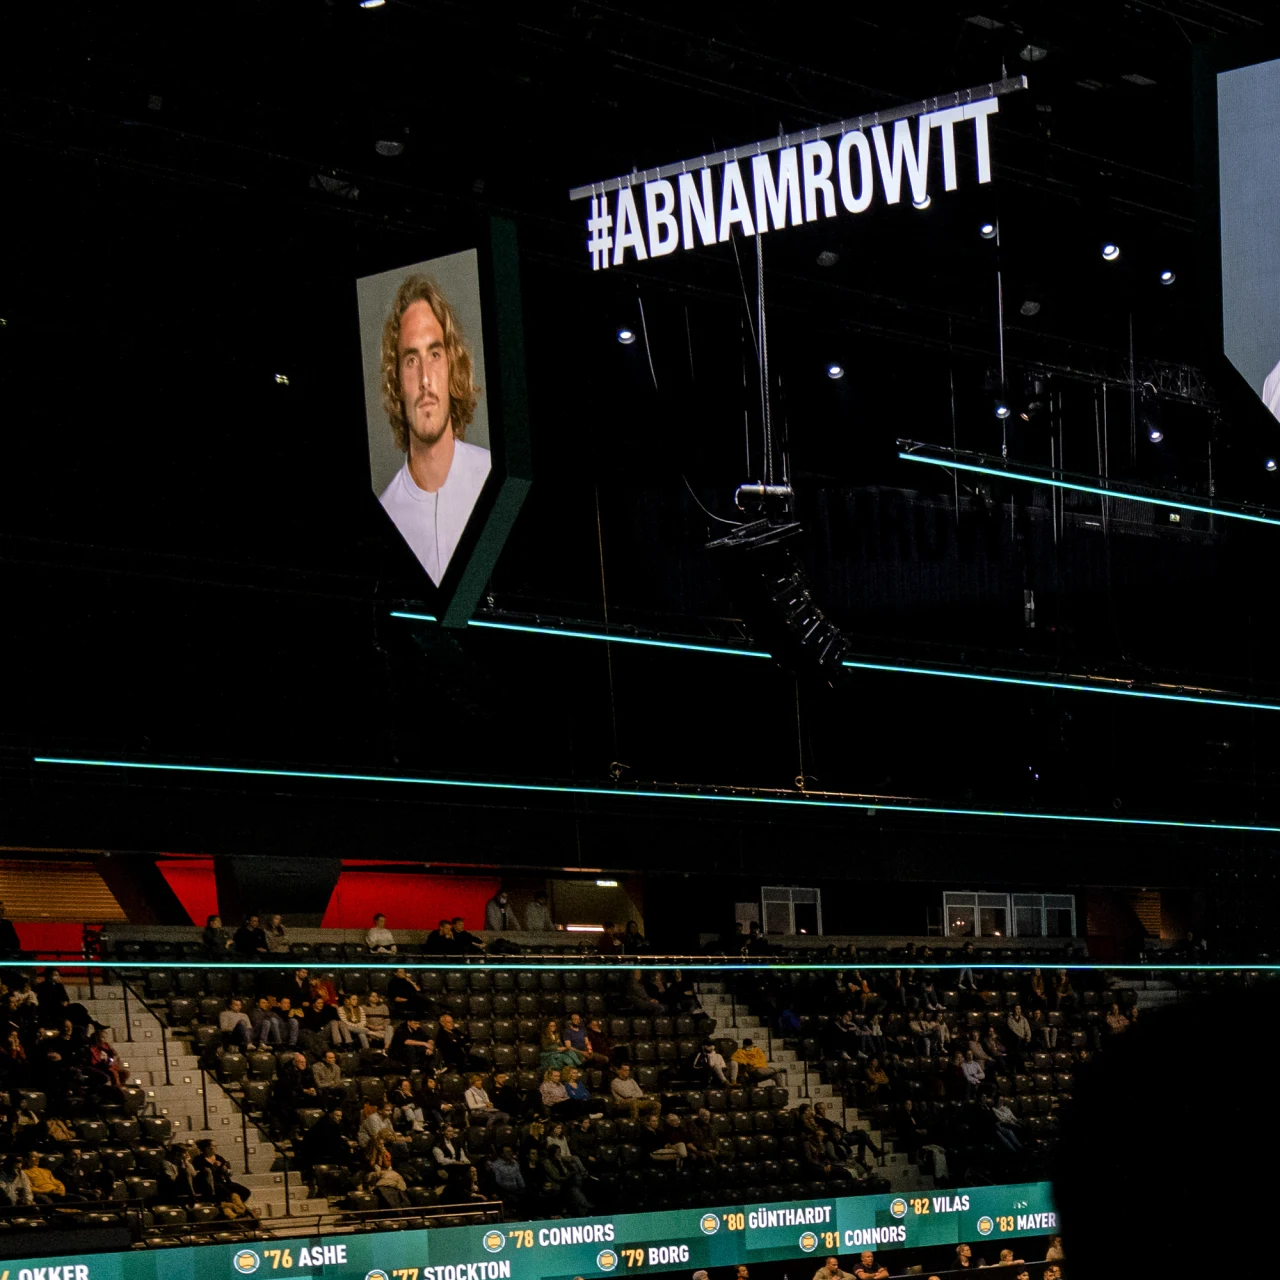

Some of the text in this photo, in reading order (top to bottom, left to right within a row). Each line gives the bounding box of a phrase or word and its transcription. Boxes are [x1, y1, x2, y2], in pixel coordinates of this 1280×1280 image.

[588, 97, 998, 270] #ABNAMROWTT
[909, 1195, 969, 1214] '82 VILAS
[723, 1206, 831, 1230] '80 GÜNTHARDT
[996, 1213, 1056, 1232] '83 MAYER
[509, 1224, 614, 1248] '78 CONNORS
[821, 1226, 906, 1248] '81 CONNORS
[264, 1245, 347, 1269] '76 ASHE
[621, 1245, 689, 1267] '79 BORG
